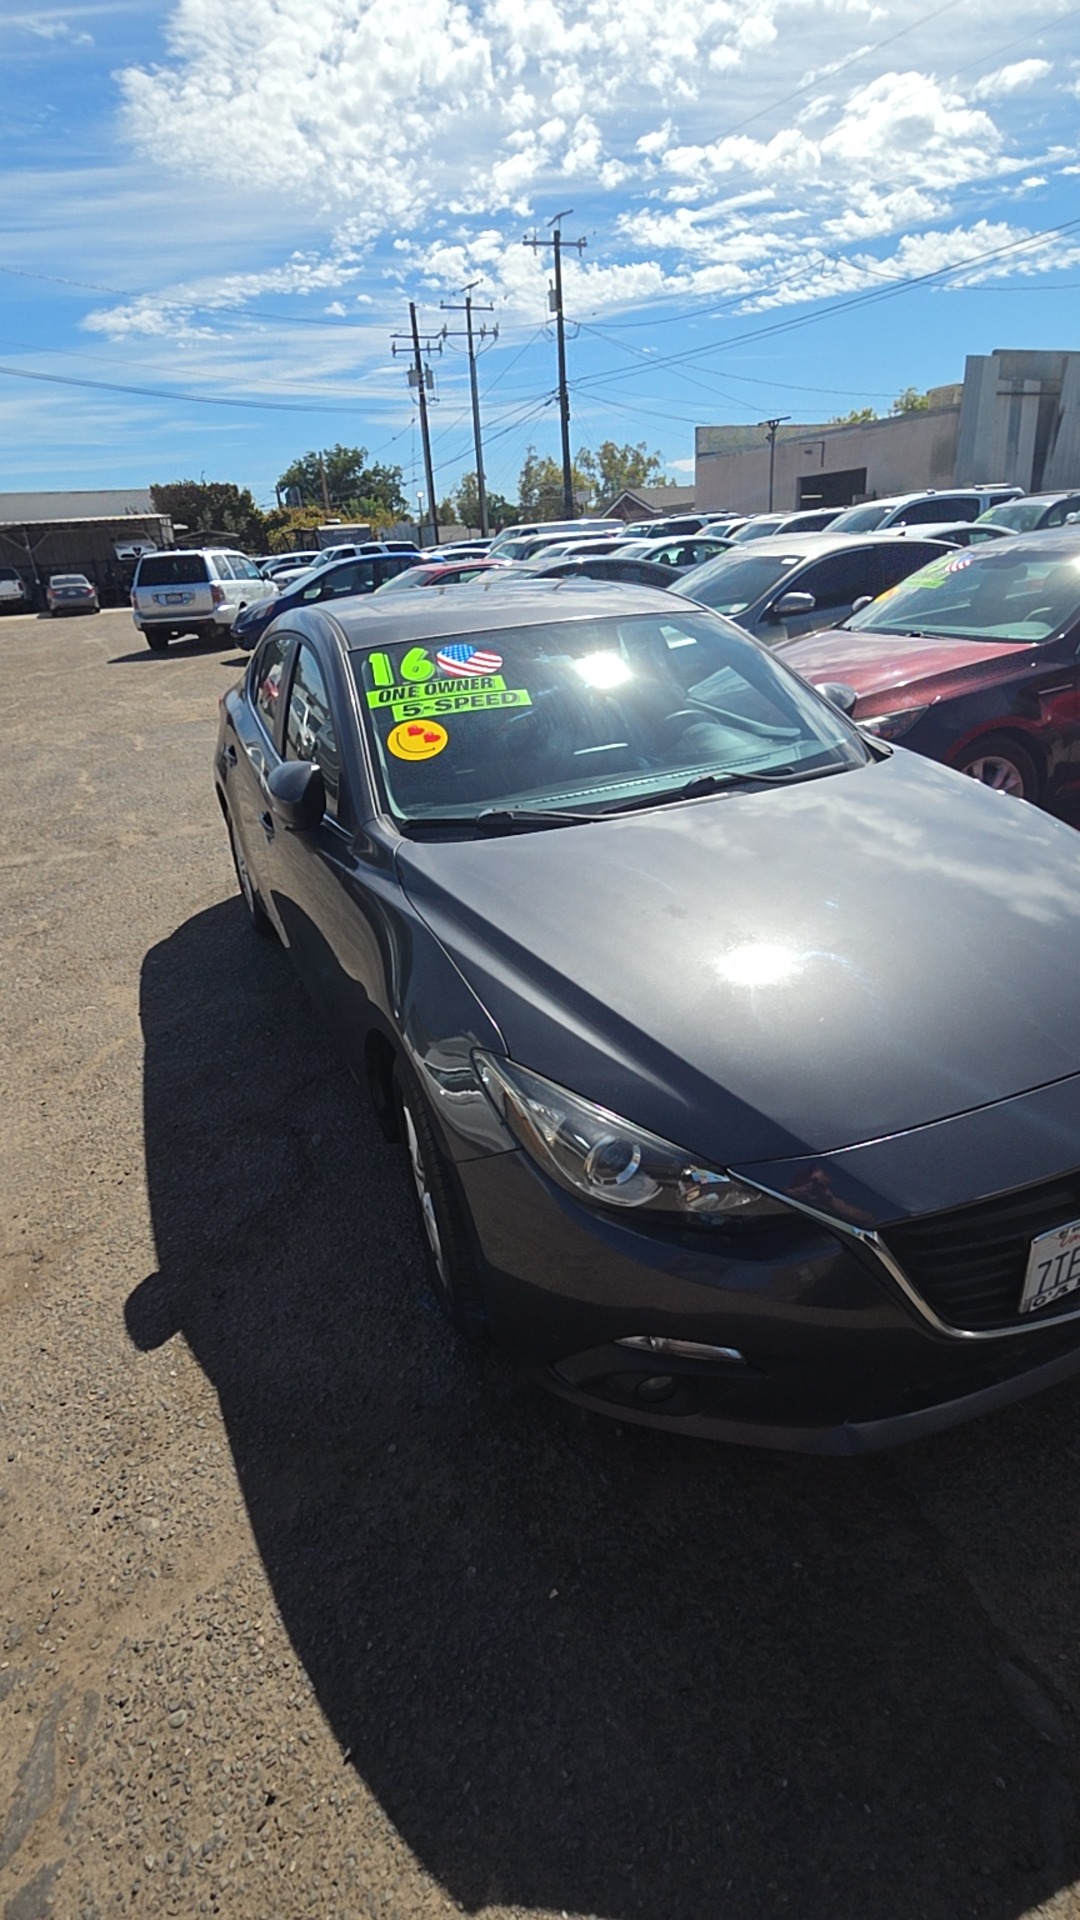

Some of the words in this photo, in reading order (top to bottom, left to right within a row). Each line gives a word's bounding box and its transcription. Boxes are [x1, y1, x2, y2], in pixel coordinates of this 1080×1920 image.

[369, 647, 435, 686] 16
[379, 686, 418, 703] ONE
[425, 677, 494, 695] OWNER
[403, 692, 519, 716] 5-SPEED
